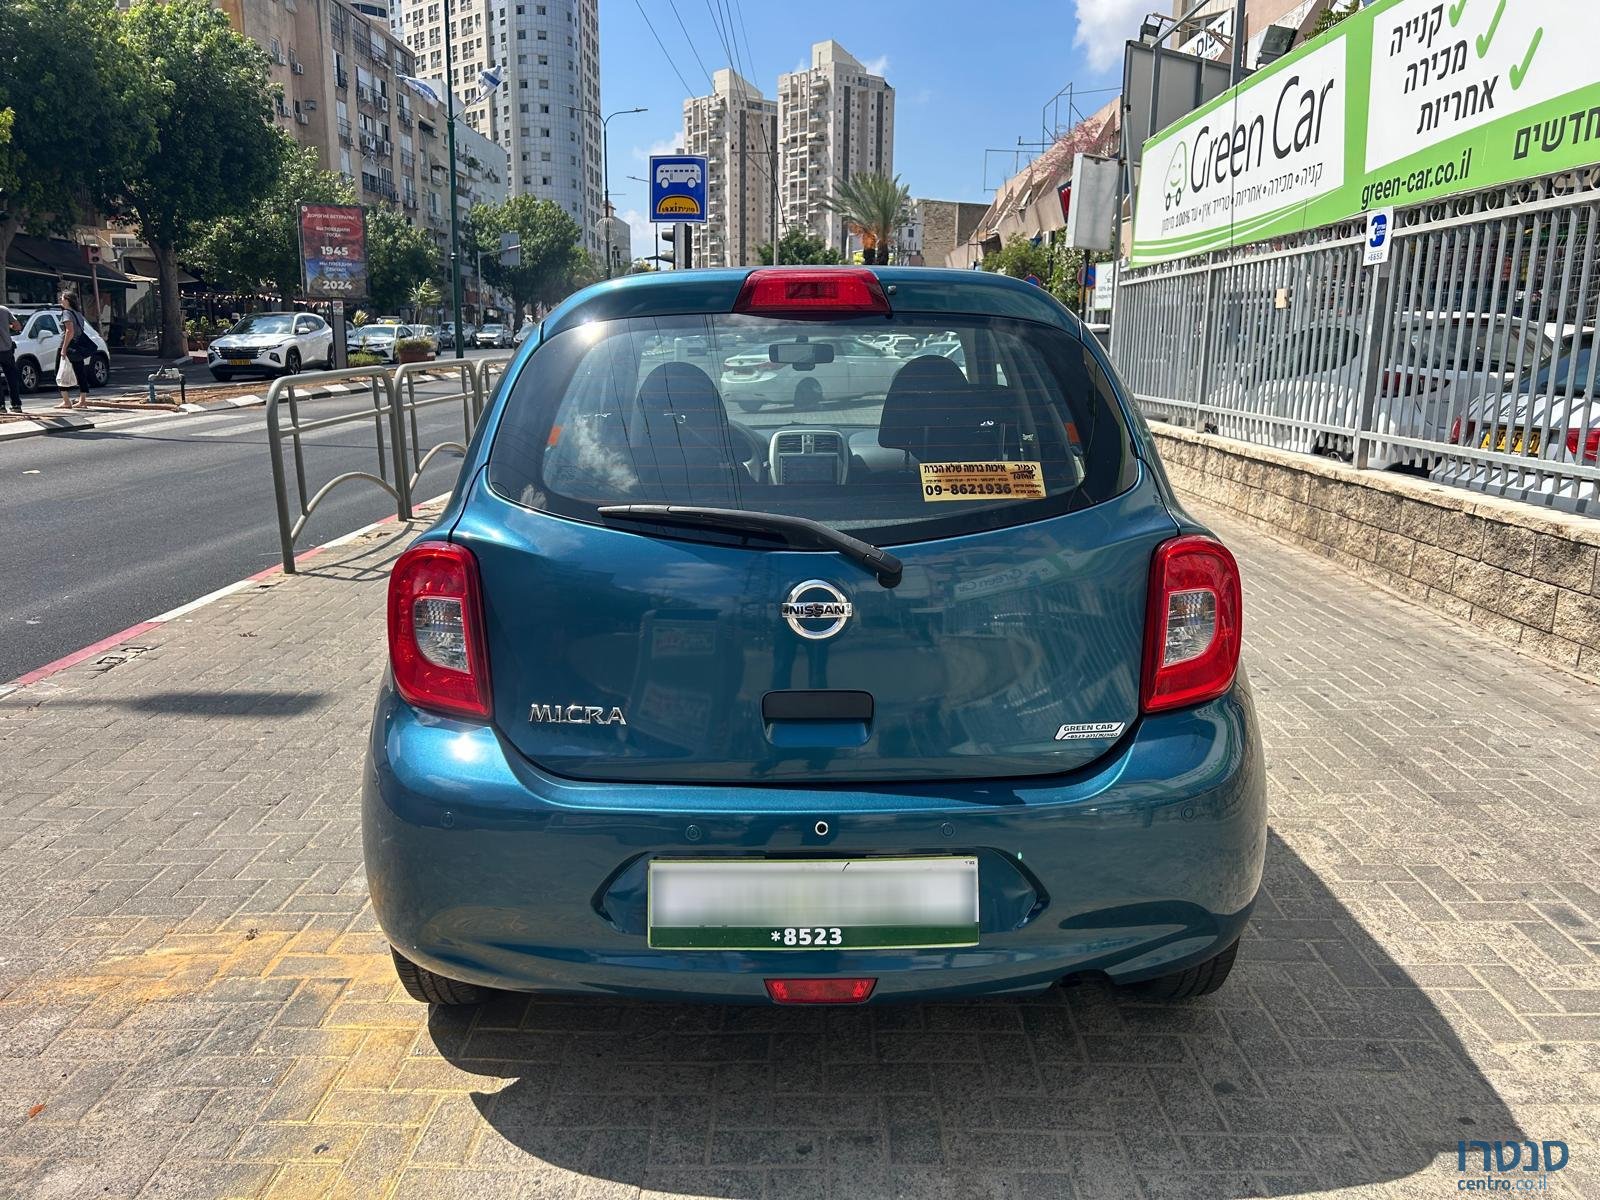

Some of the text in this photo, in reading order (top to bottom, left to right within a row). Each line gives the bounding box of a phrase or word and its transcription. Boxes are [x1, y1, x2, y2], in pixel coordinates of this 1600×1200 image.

[1390, 4, 1444, 57] קנייה
[1404, 40, 1468, 94] מכירה
[1416, 75, 1499, 135] אחריות
[1191, 76, 1334, 193] Green Car
[1268, 173, 1293, 196] מכירה
[1300, 163, 1323, 187] קניה
[1361, 148, 1472, 210] green-car.co.il
[1235, 184, 1262, 207] אחריות
[1176, 208, 1191, 228] 100%
[320, 246, 349, 256] 1945
[322, 281, 352, 290] 2024
[946, 464, 962, 473] שלא
[964, 464, 984, 473] ברמה
[986, 464, 1007, 473] איכות
[925, 483, 1012, 496] 09-8621936
[790, 606, 845, 616] NISSAN
[529, 704, 627, 725] MICRA
